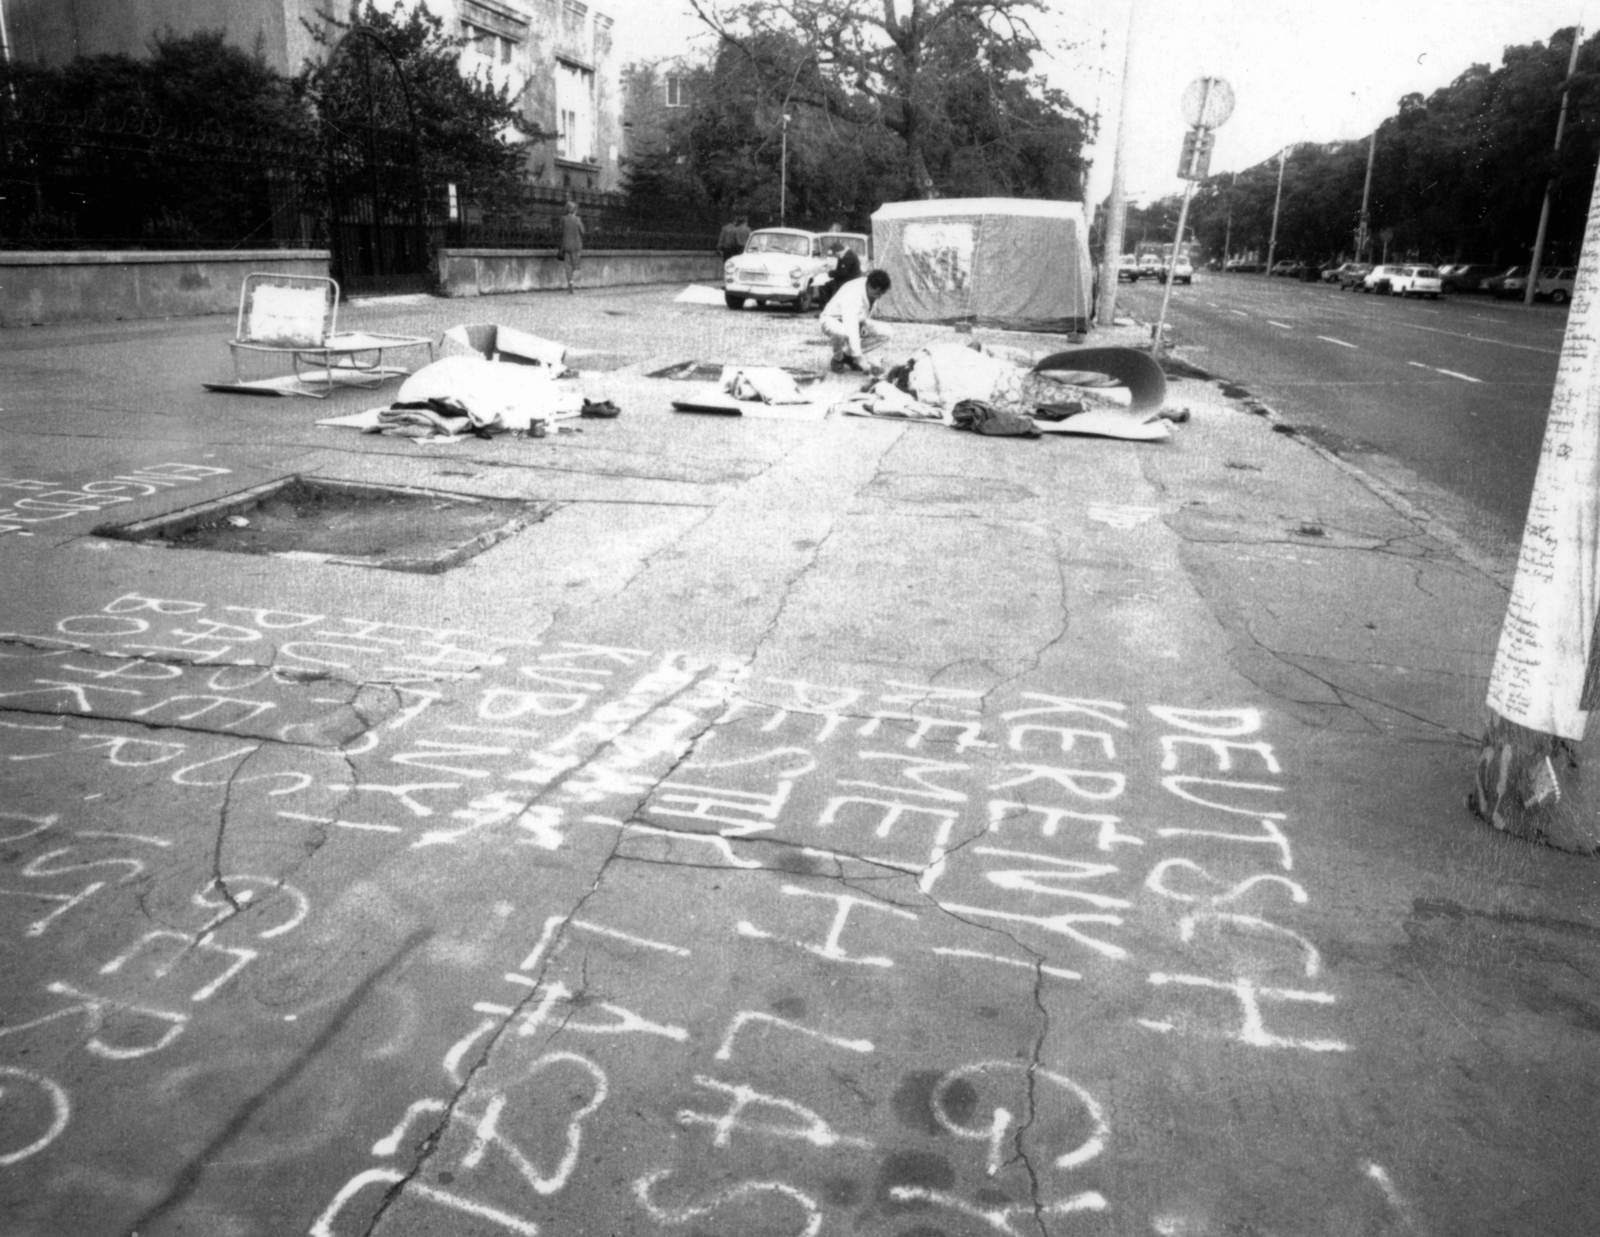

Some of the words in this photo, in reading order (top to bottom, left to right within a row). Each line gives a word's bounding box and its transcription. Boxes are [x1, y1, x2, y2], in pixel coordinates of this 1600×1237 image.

[9, 617, 438, 767] HUBER
[170, 627, 544, 796] LANTOS
[276, 641, 653, 833] KUBINYI
[583, 675, 866, 867] PESTHY
[736, 679, 998, 967] NÉMETH
[932, 691, 1145, 980] KERÉNYI
[1136, 703, 1353, 1052] DEUTSCH
